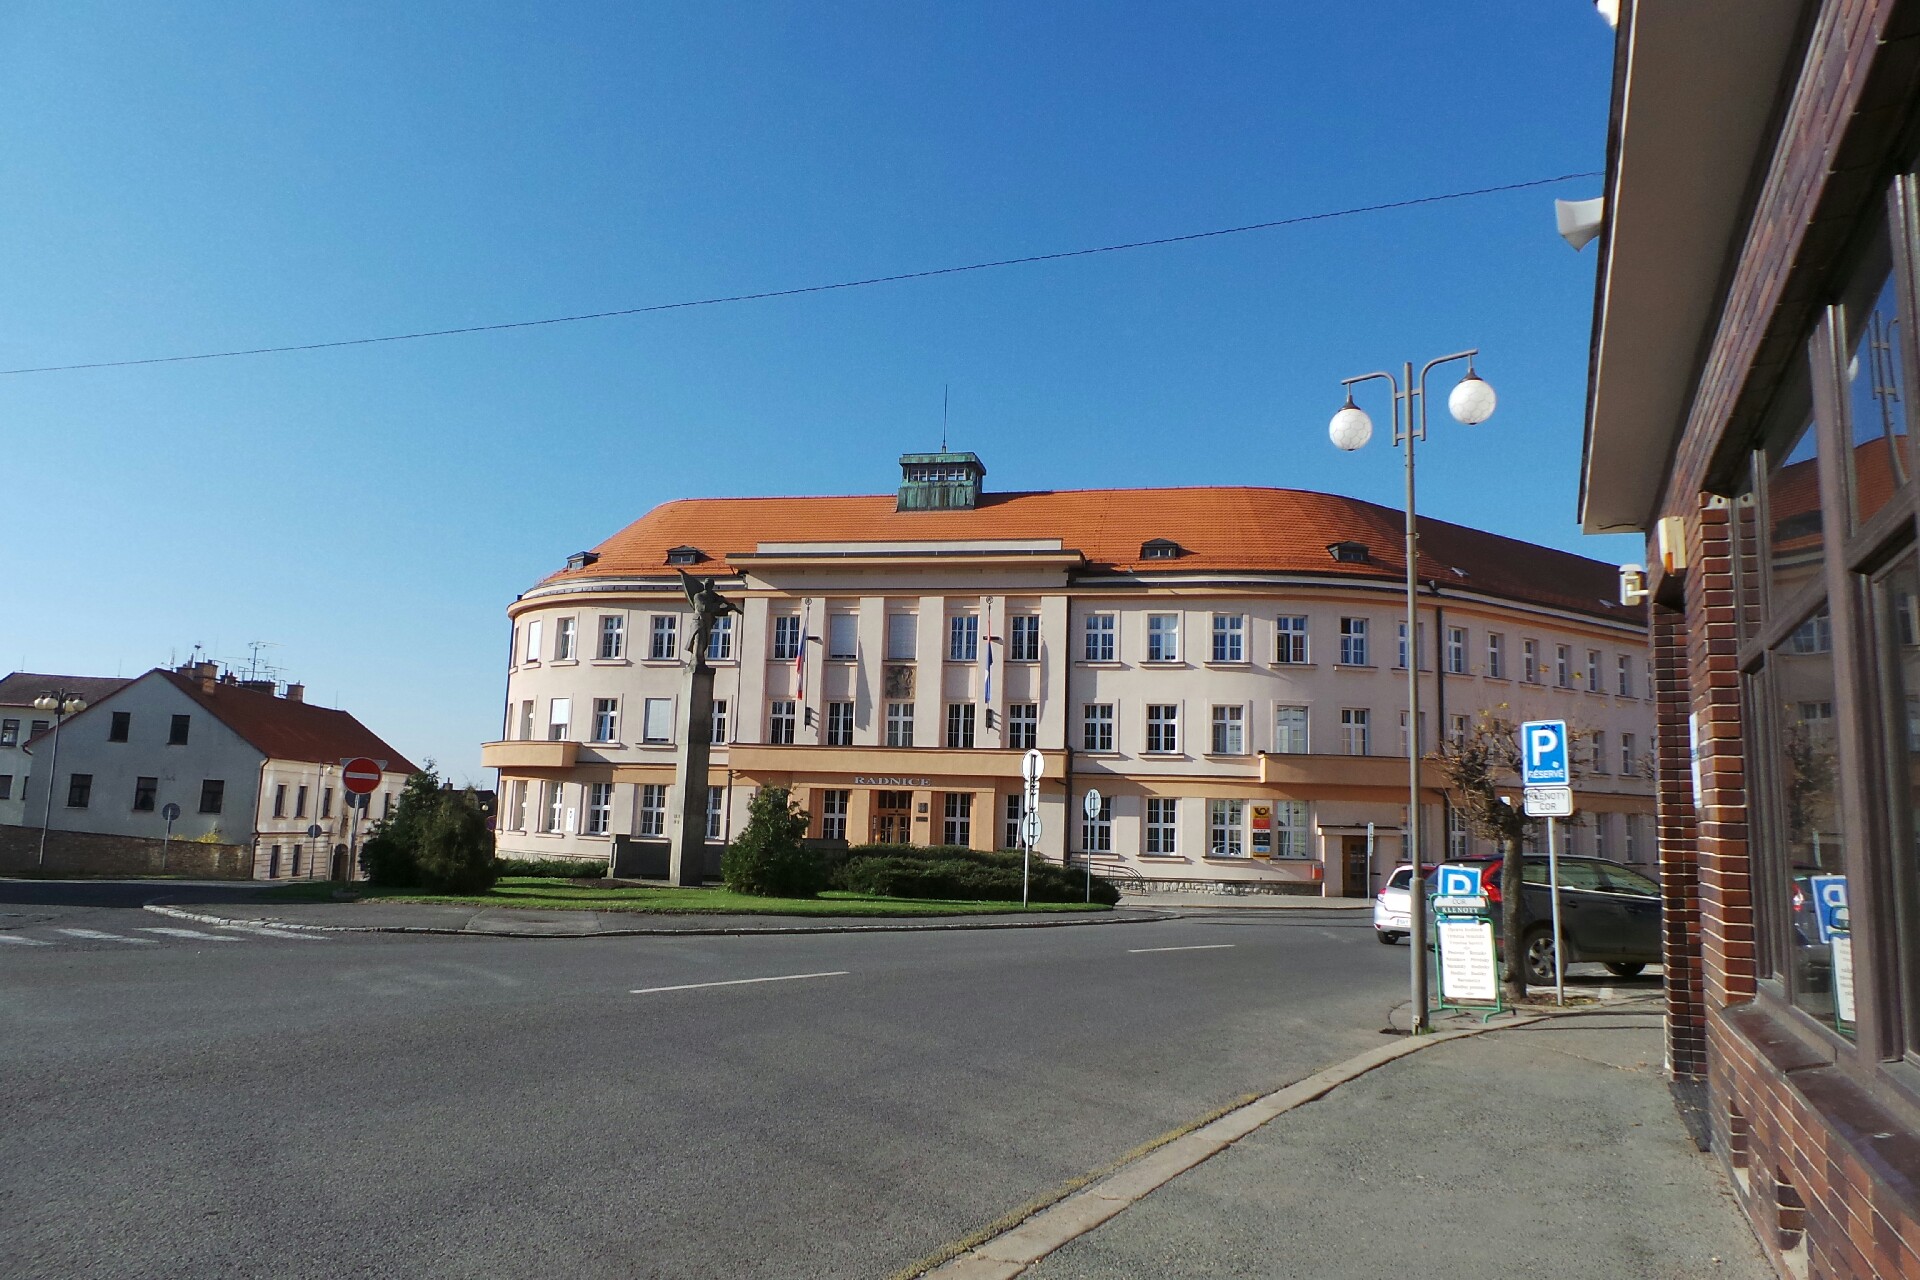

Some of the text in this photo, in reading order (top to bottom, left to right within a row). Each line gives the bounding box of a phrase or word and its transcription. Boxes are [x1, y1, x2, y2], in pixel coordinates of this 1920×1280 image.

[1532, 730, 1558, 766] P
[855, 776, 931, 786] RADNICE
[1540, 803, 1557, 811] COR
